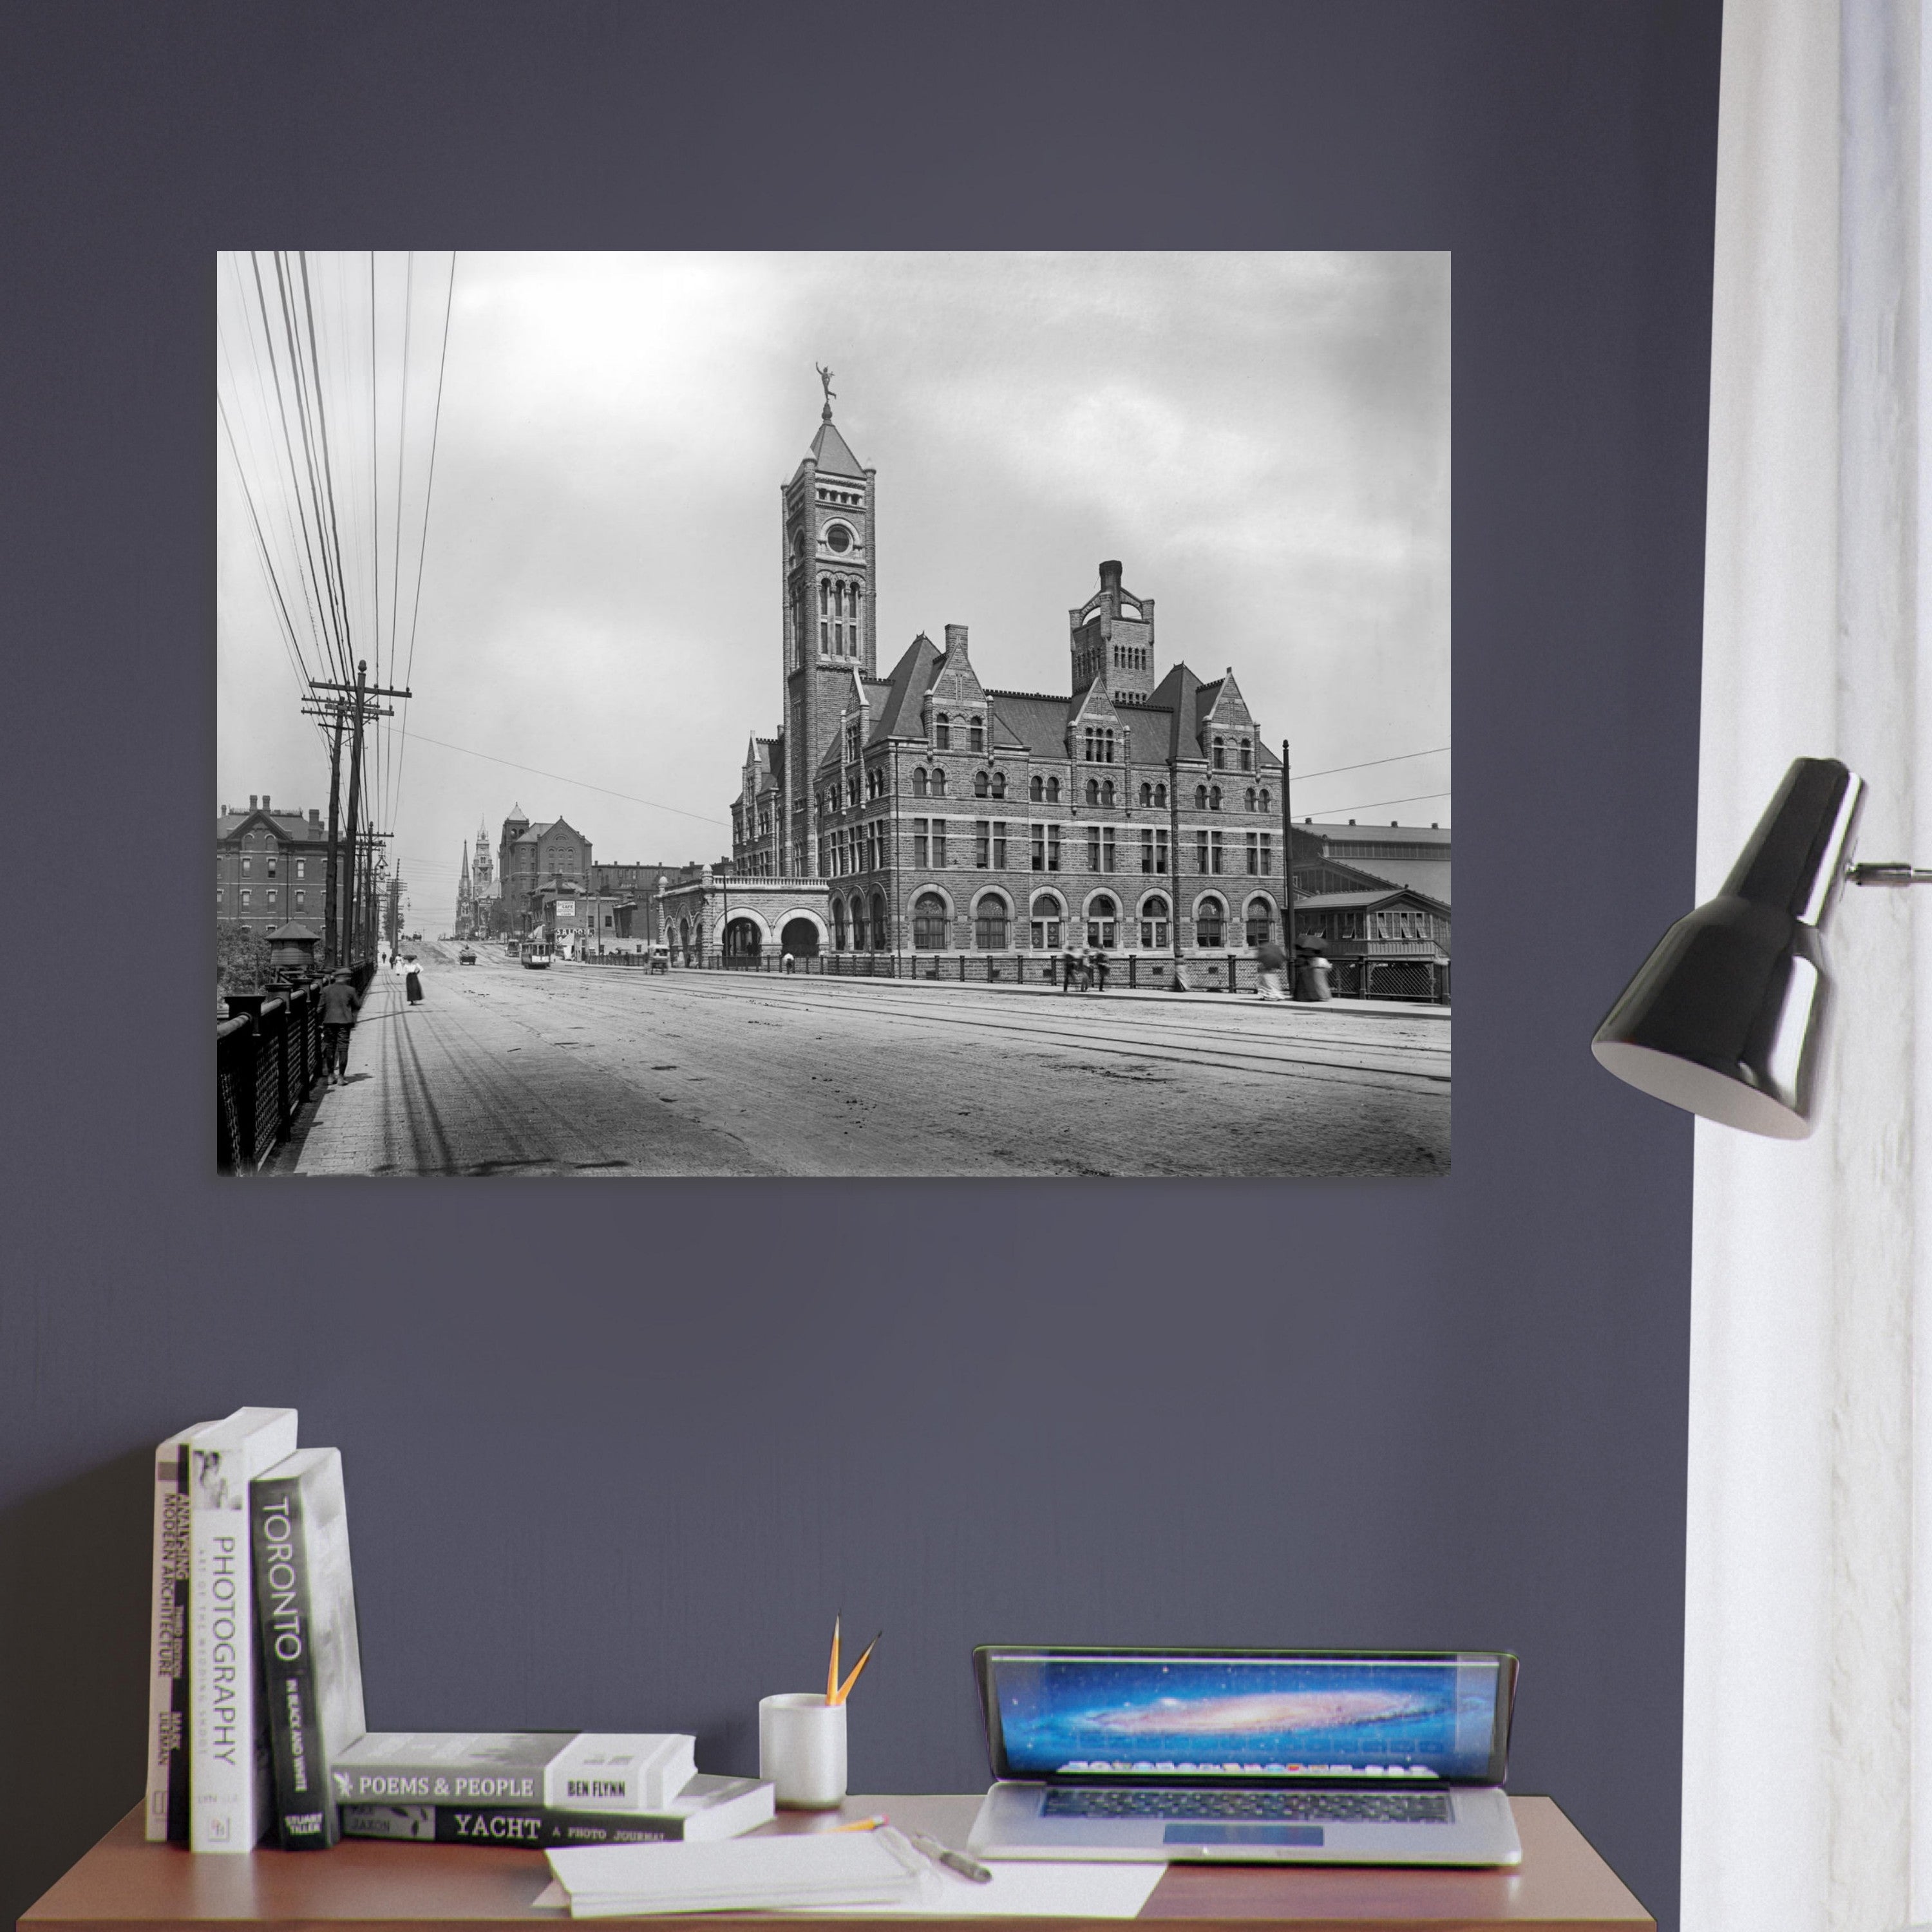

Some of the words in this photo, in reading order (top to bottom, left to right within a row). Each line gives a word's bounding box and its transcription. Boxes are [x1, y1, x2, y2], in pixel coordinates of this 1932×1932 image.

[163, 1493, 177, 1560] MODERN
[263, 1495, 301, 1662] TORONTO
[158, 1566, 175, 1676] ARCHITECTURE
[213, 1537, 236, 1766] PHOTOGRAPHY
[291, 1730, 303, 1756] AND
[359, 1777, 429, 1797] POEMS
[433, 1777, 450, 1796] &
[455, 1777, 534, 1797] PEOPLE
[567, 1780, 589, 1797] BEN
[592, 1780, 625, 1797] FLYNN
[454, 1814, 542, 1840] YACHT
[552, 1826, 561, 1837] A
[568, 1826, 607, 1840] PHOTO
